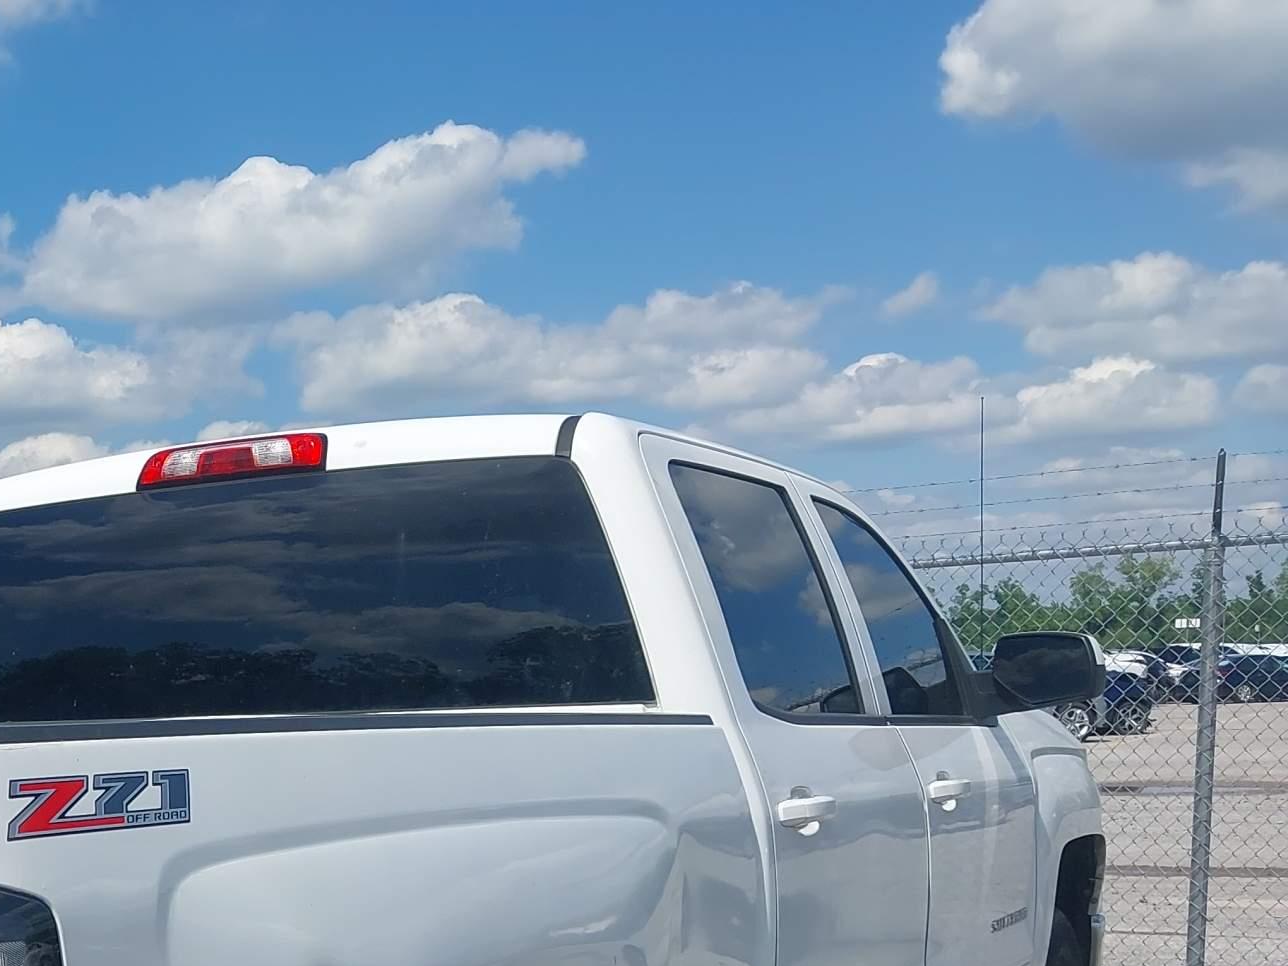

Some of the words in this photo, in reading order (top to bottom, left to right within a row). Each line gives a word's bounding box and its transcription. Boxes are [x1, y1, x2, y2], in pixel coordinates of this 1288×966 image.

[7, 769, 191, 841] Z71
[127, 813, 150, 823] OFF
[154, 810, 187, 821] ROAD
